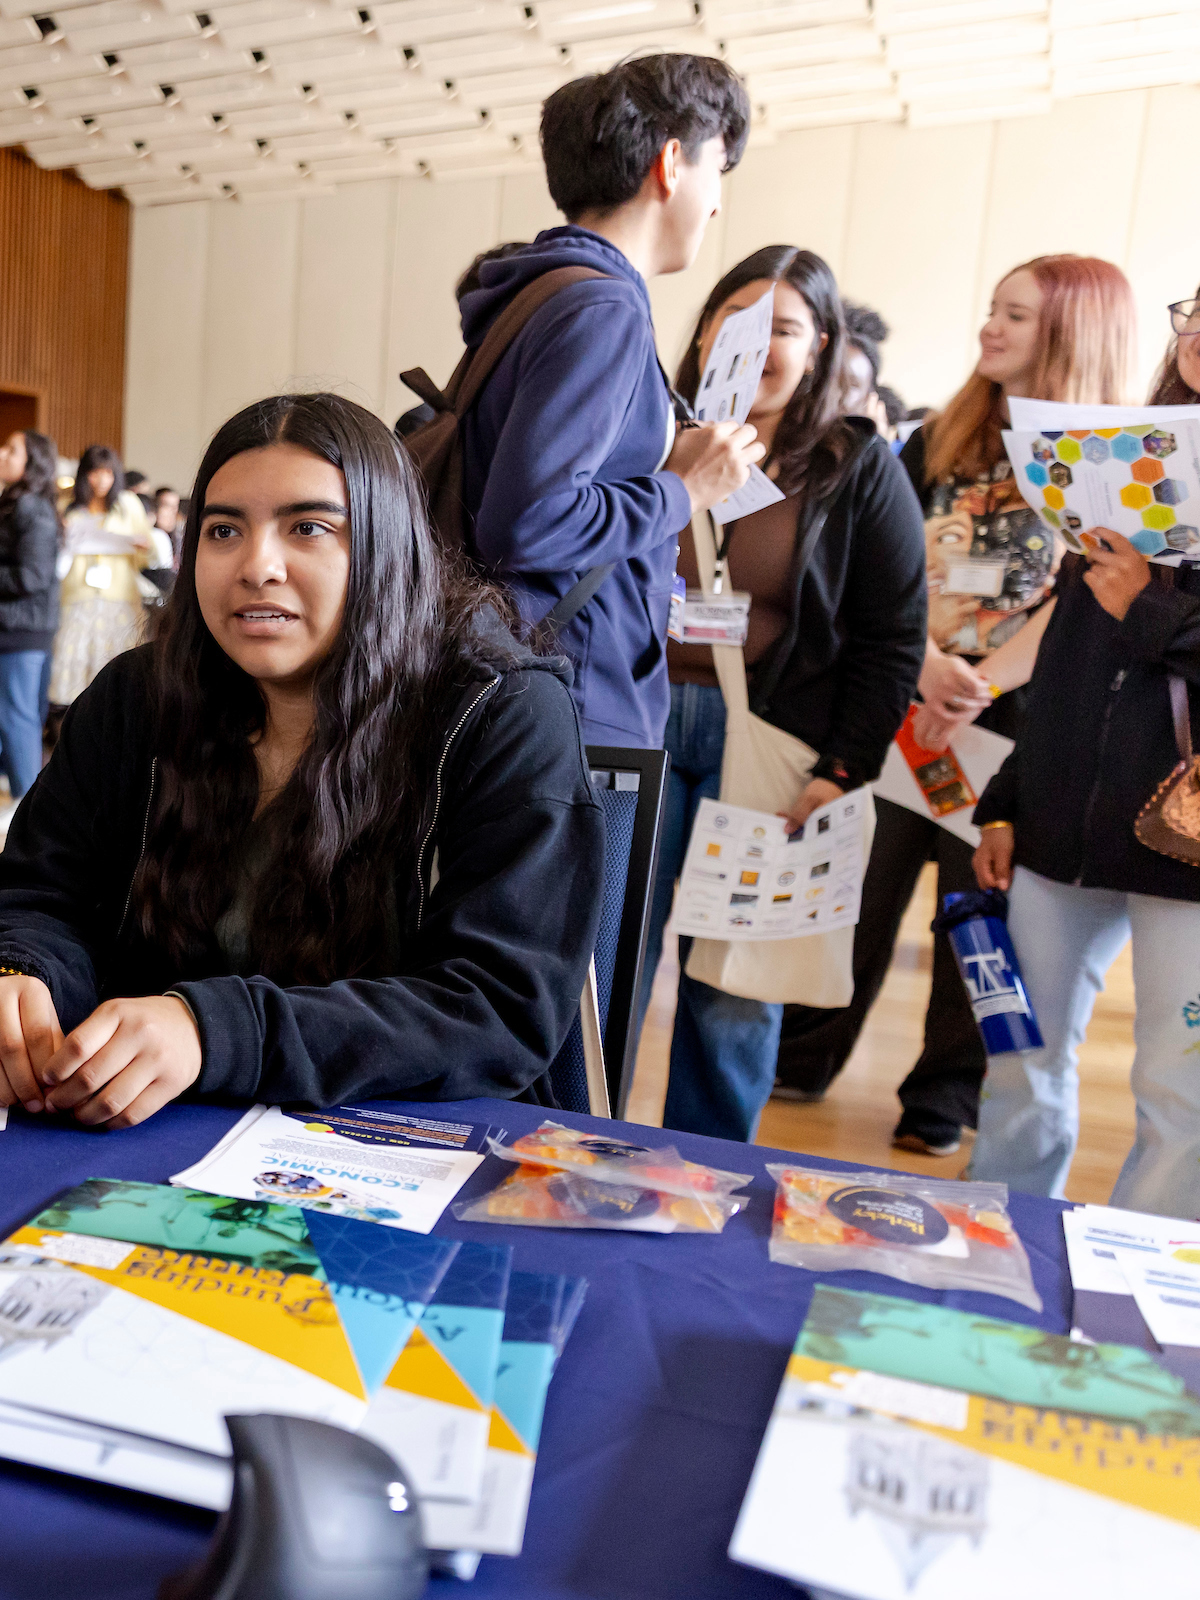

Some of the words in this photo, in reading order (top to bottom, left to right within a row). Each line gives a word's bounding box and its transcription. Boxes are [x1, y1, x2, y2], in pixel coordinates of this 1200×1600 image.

[340, 1130, 373, 1139] APPEAL
[389, 1138, 410, 1146] HOW
[270, 1151, 332, 1167] APPEAL
[261, 1156, 421, 1192] ECONOMIC
[335, 1165, 424, 1185] HARDSHIP
[123, 1261, 315, 1314] Funding
